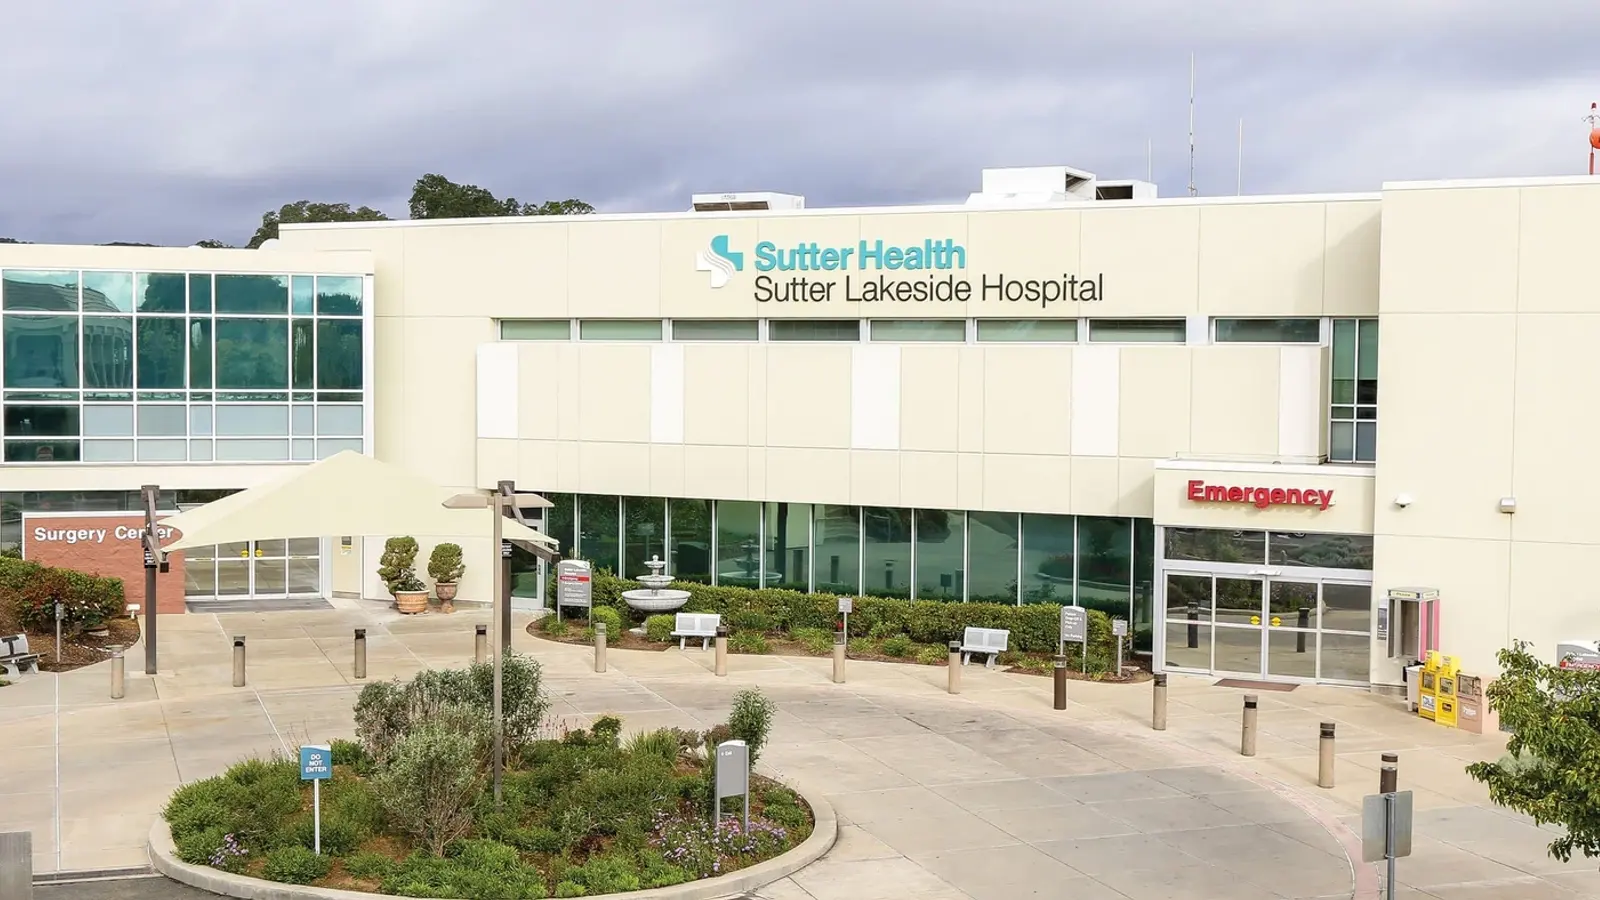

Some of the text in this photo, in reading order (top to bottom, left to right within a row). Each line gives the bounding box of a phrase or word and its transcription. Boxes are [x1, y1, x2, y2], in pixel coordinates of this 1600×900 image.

[754, 238, 966, 271] Sutter Health
[754, 273, 1104, 308] Sutter Lakeside Hospital
[1188, 480, 1334, 511] Emergency
[34, 525, 174, 543] Surgery Cener
